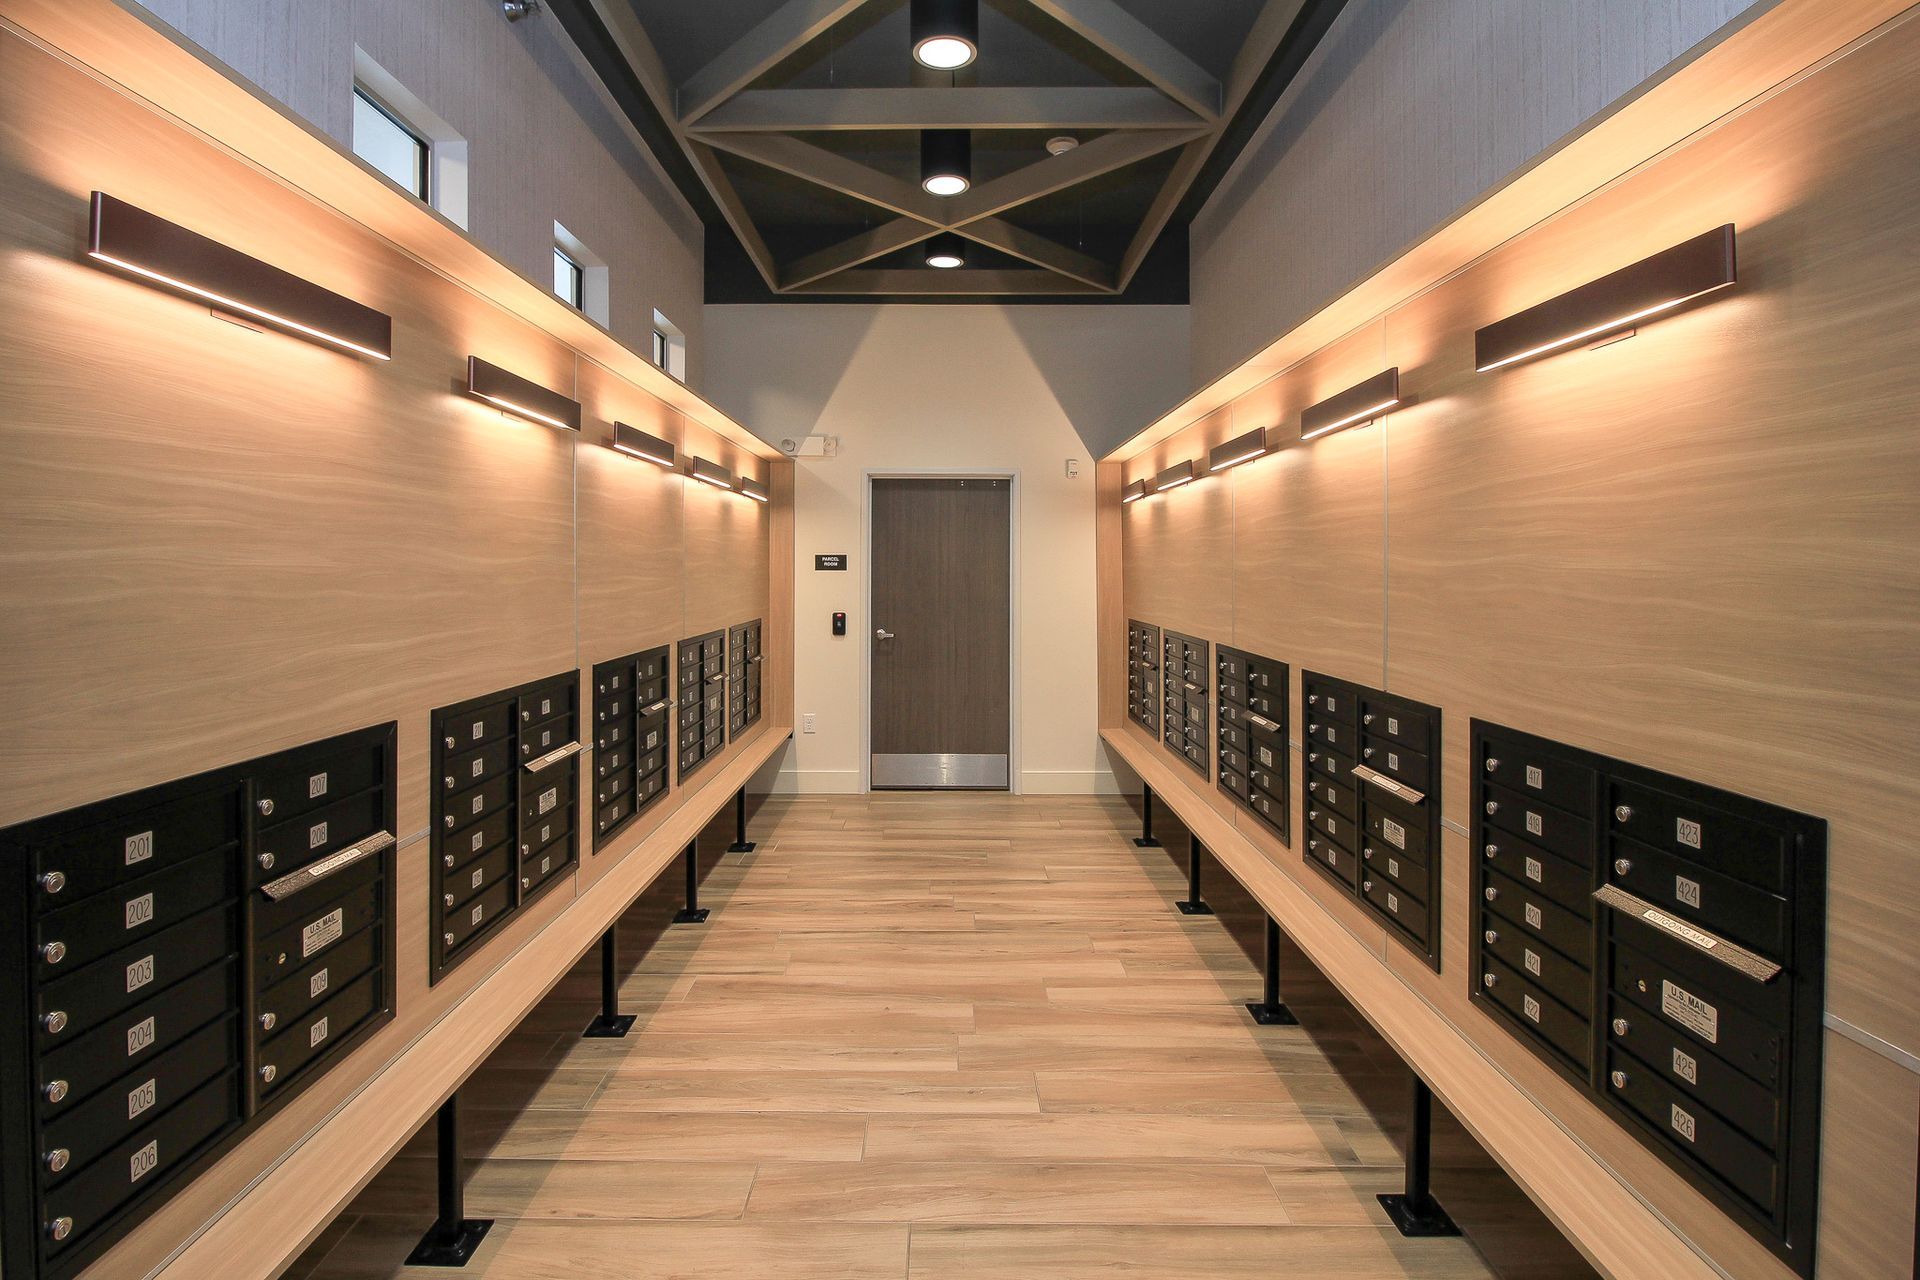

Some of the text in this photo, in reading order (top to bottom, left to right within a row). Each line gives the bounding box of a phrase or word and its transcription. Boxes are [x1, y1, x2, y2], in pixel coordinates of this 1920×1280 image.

[311, 776, 326, 795] 207
[1528, 769, 1541, 787] 417
[311, 825, 326, 846] 208
[1528, 815, 1541, 834] 418
[1679, 823, 1699, 845] 423
[129, 836, 150, 861] 201
[1527, 861, 1540, 880] 419
[1678, 881, 1698, 904] 424
[129, 898, 151, 925] 202
[1527, 907, 1540, 926] 420
[310, 914, 337, 934] U.S. MAIL
[1648, 911, 1714, 947] OUTGOING MAIL
[129, 960, 152, 988] 203
[1526, 953, 1539, 972] 421
[312, 972, 327, 995] 209
[1526, 999, 1538, 1018] 422
[1671, 986, 1685, 1002] U.S.
[1688, 996, 1708, 1016] MAIL
[130, 1022, 152, 1050] 204
[312, 1022, 326, 1044] 210
[1676, 1054, 1694, 1079] 425
[131, 1084, 153, 1114] 205
[1674, 1110, 1693, 1137] 426
[133, 1146, 155, 1176] 206
